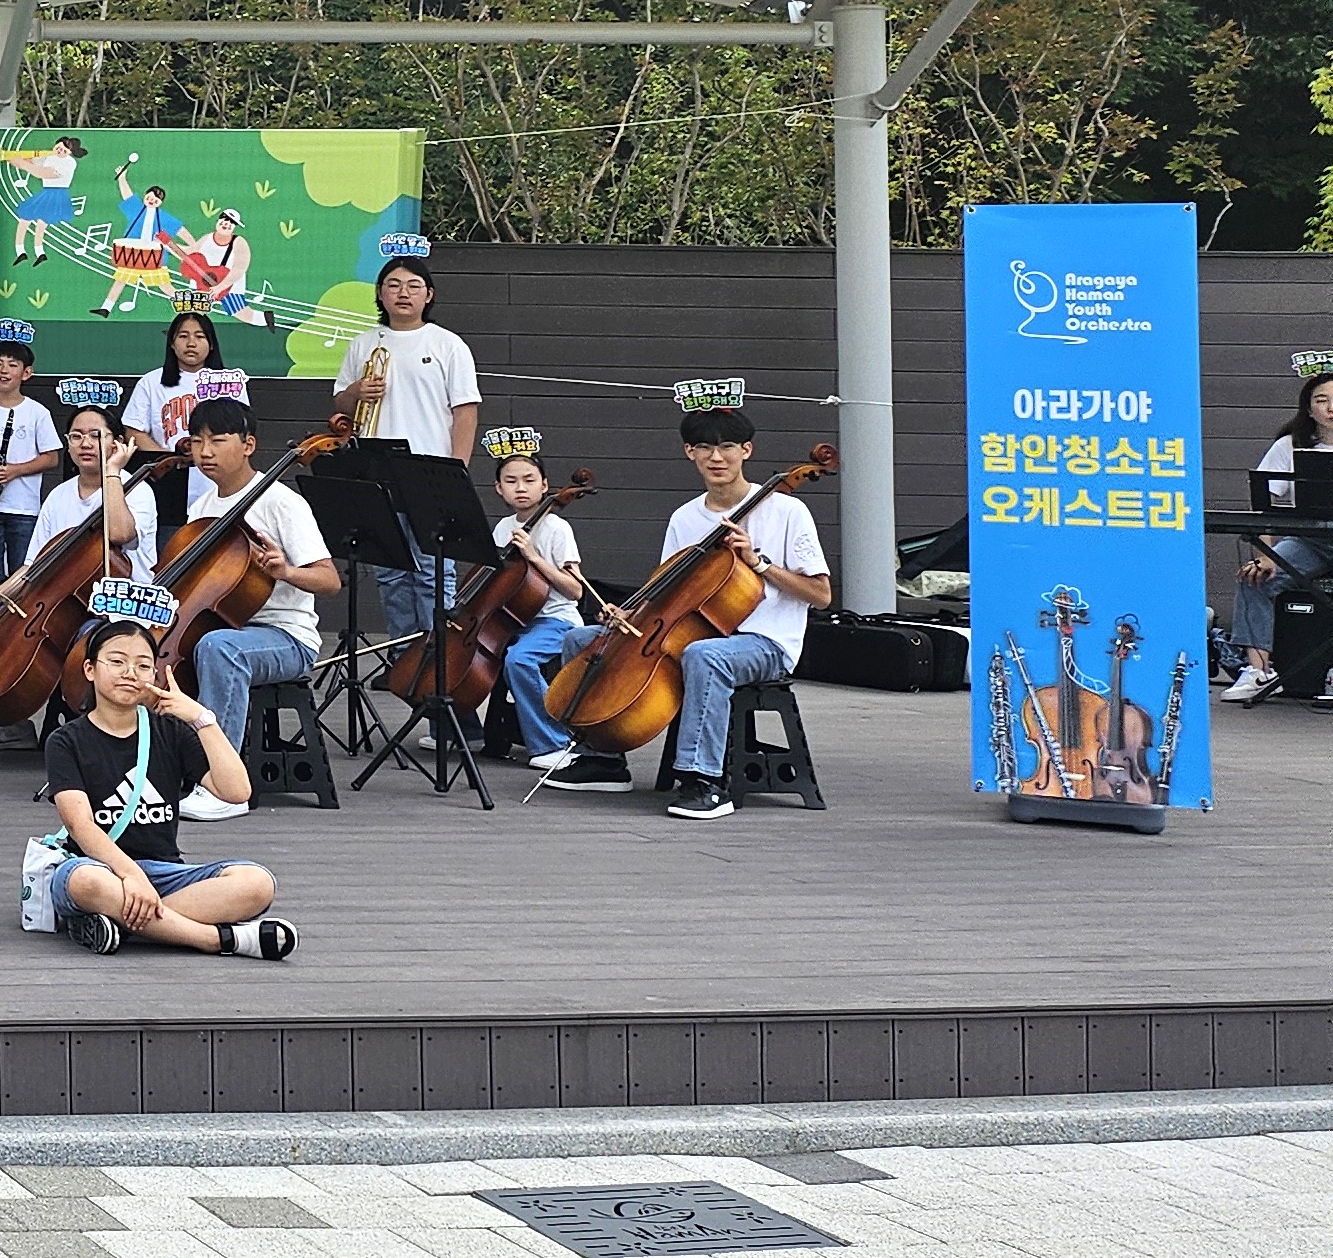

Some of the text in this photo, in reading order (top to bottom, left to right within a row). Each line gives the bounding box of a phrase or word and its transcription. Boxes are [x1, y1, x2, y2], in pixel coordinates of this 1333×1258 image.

[1064, 272, 1138, 290] Aragaya
[1064, 288, 1124, 302] Haman
[1064, 302, 1112, 317] Youth
[1064, 317, 1152, 332] Orchestra
[678, 381, 741, 398] 푸른지구를
[684, 395, 740, 409] 희망해요
[1013, 388, 1153, 422] 아라가야
[981, 433, 1186, 478] 함안청소년
[981, 487, 1190, 532] 오케스트라
[103, 581, 169, 608] 푸른 지구는
[93, 594, 172, 624] 우리의 미래
[94, 804, 174, 825] addas
